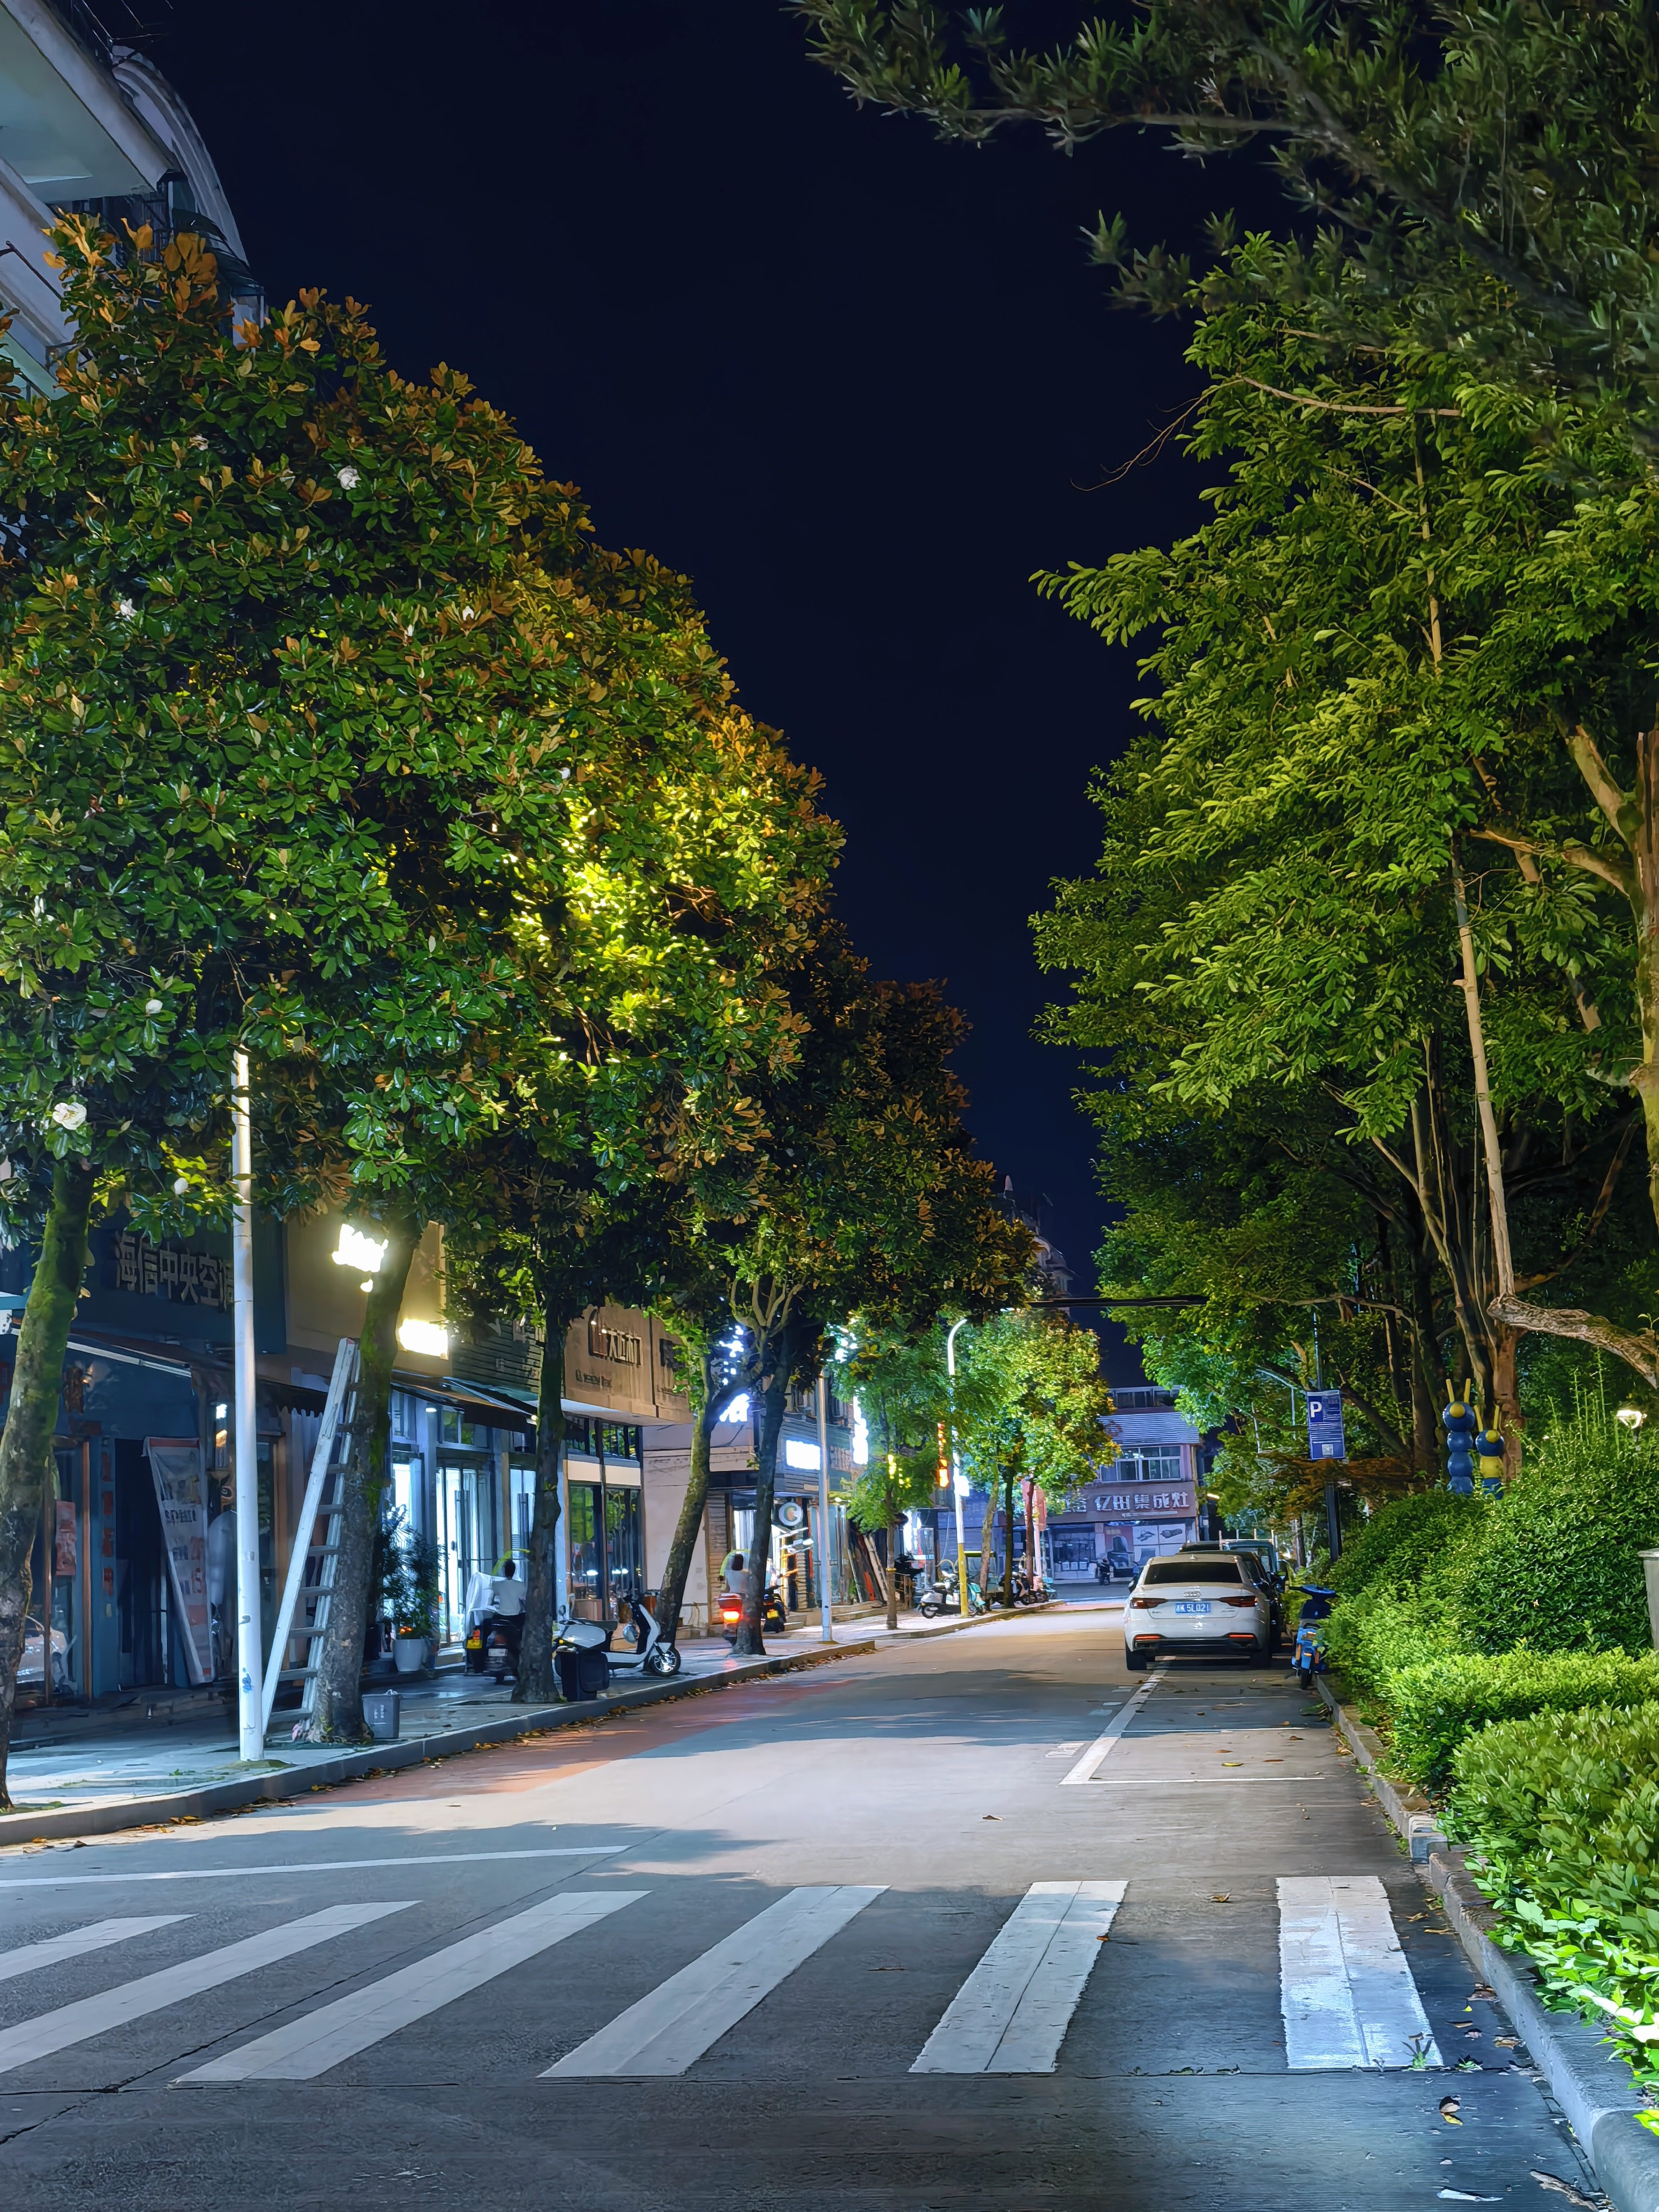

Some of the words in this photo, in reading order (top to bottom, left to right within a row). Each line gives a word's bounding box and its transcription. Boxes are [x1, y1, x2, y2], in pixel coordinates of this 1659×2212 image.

[1310, 1401, 1322, 1418] P
[1095, 1492, 1189, 1511] 亿田集成灶
